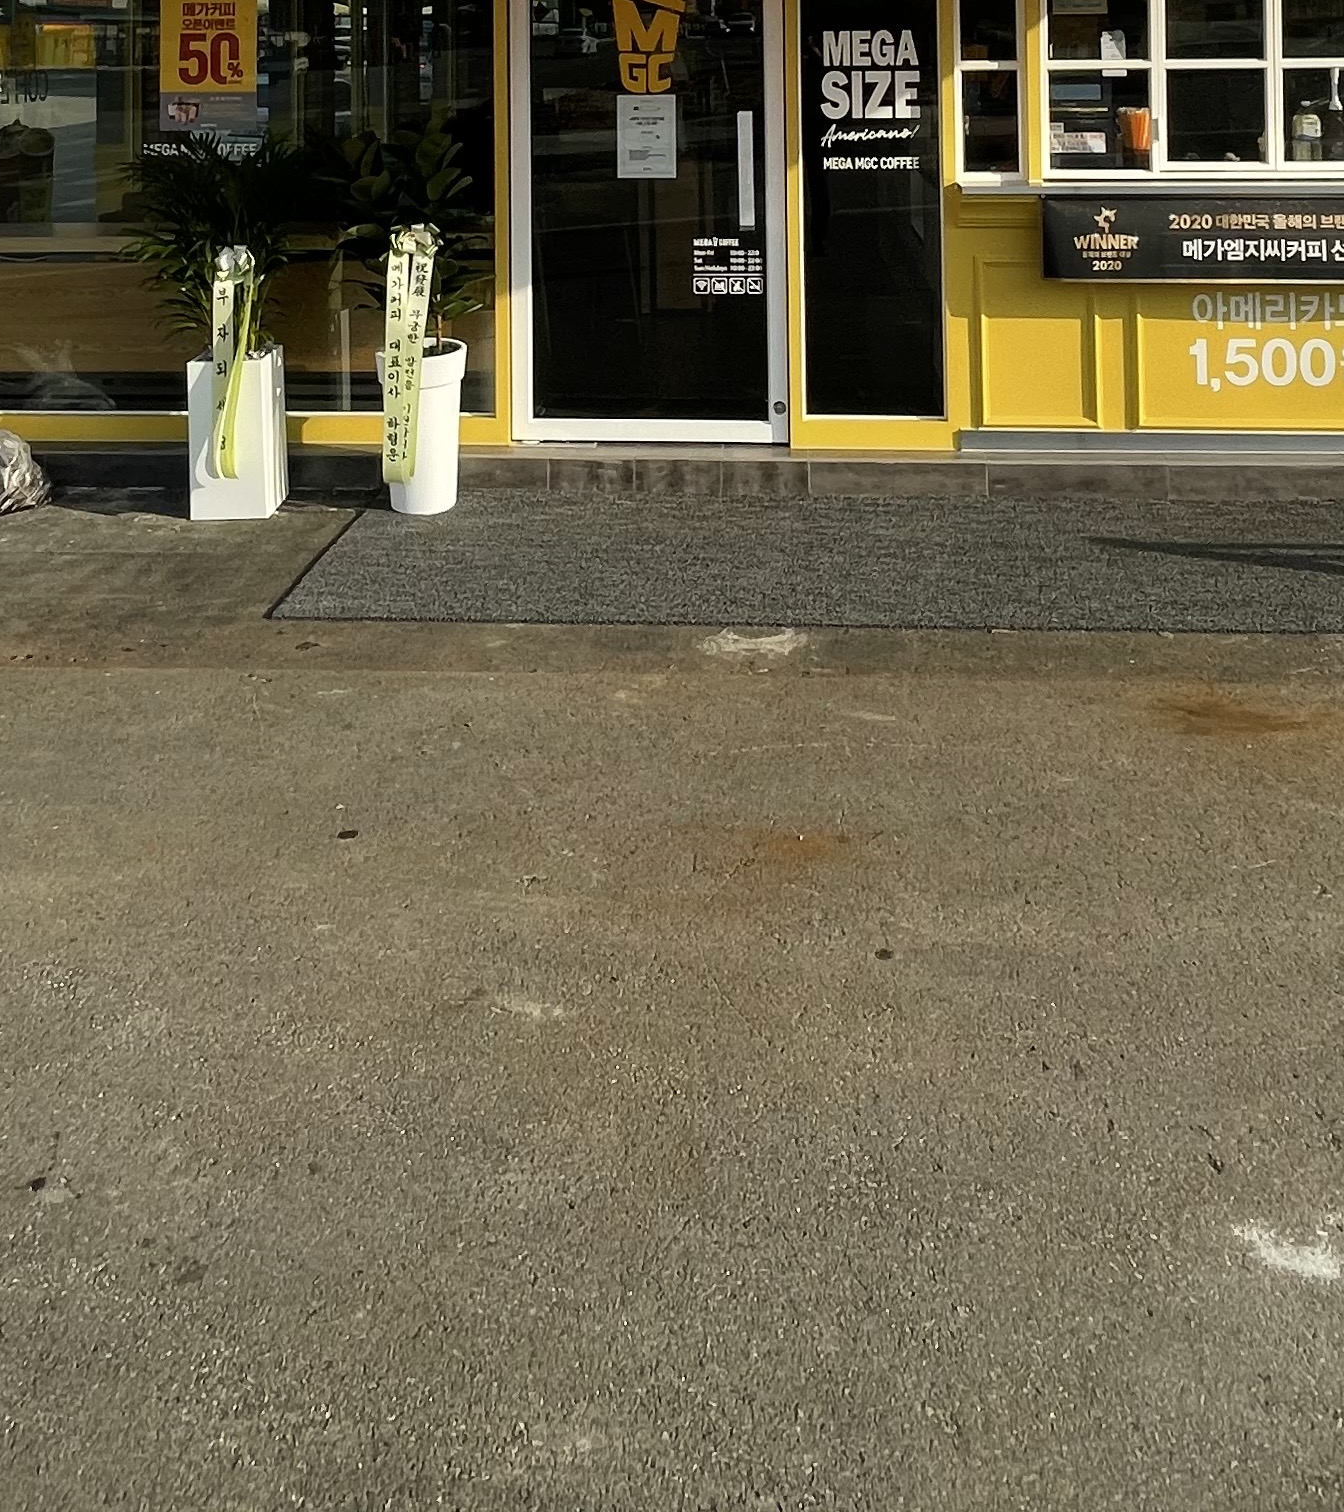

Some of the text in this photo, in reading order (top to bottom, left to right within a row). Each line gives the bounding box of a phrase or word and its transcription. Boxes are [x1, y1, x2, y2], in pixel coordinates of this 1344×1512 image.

[182, 2, 236, 17] 메가커피
[822, 29, 919, 67] MEGA
[820, 70, 921, 120] SIZE
[823, 156, 920, 170] MEGA MGC COFFEE
[1168, 214, 1212, 230] 2020
[1215, 214, 1270, 230] 대한민국
[1272, 214, 1317, 230] 올해의
[1073, 233, 1139, 250] WINNER
[1182, 238, 1327, 262] 메가엠지씨커피
[1092, 261, 1123, 271] 2020
[387, 338, 403, 399] 대표이사
